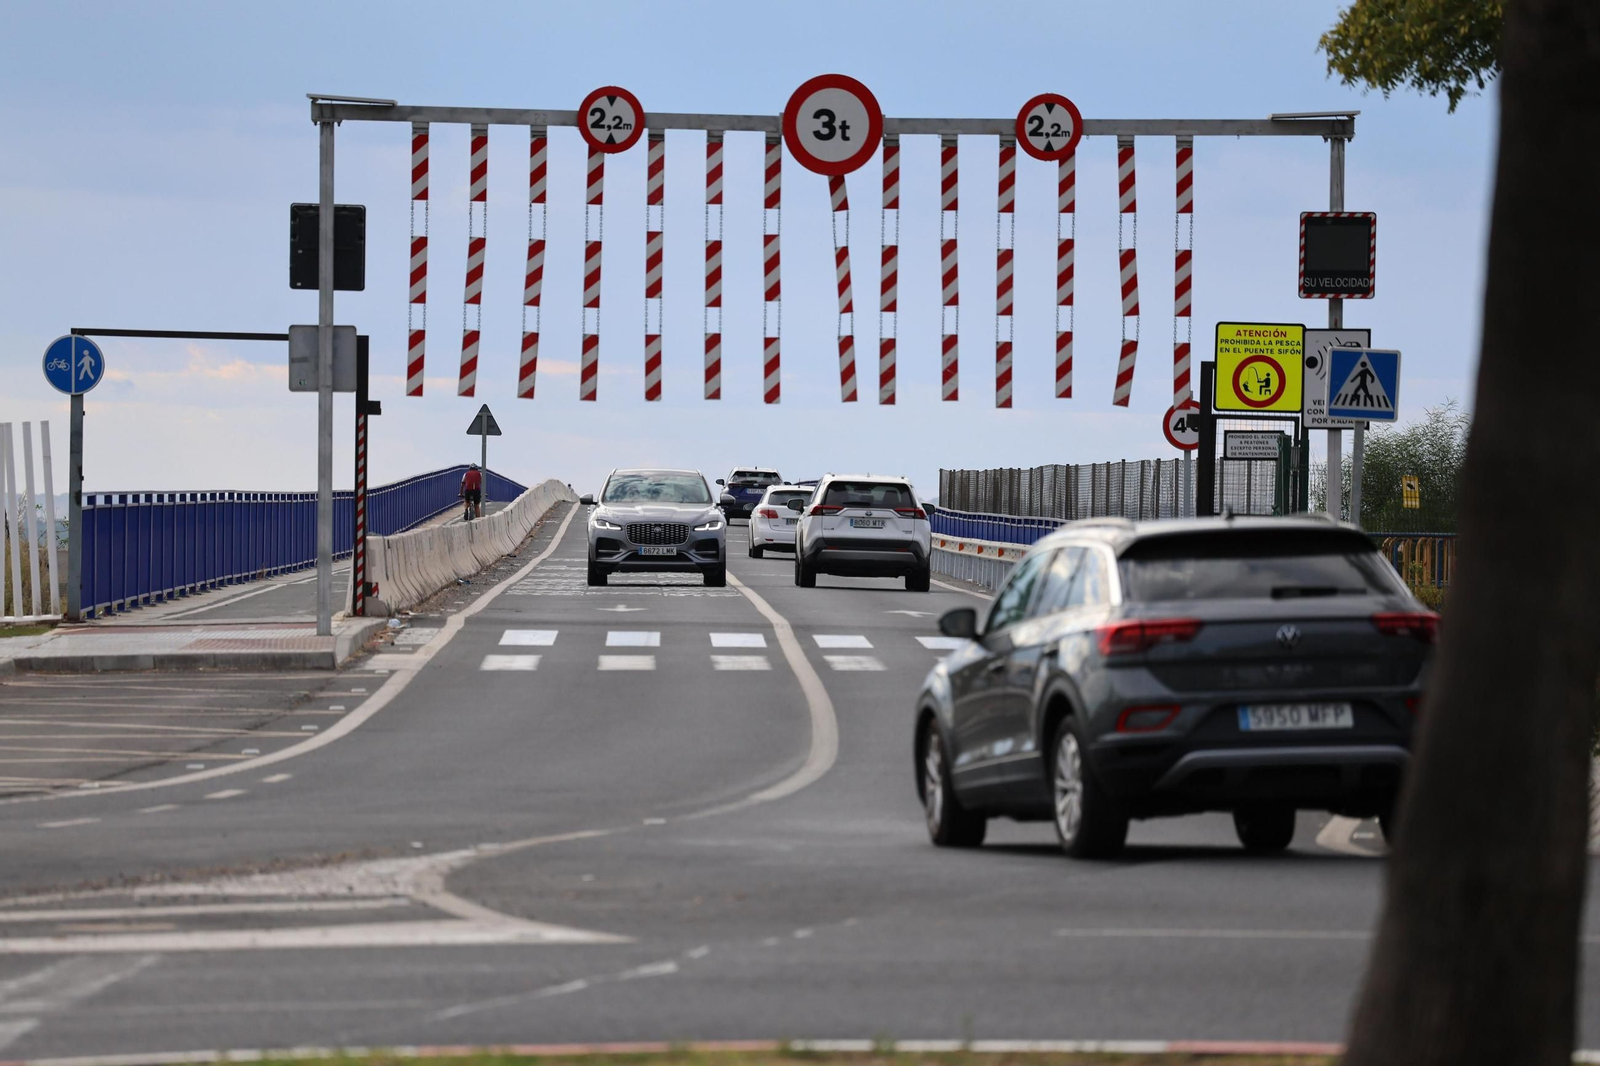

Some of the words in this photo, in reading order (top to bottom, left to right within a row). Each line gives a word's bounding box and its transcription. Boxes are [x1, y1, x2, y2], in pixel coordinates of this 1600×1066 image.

[590, 107, 632, 131] 2,2m
[812, 108, 850, 141] 3t
[1028, 115, 1070, 139] 2,2m
[1304, 277, 1317, 287] SU
[1318, 277, 1370, 288] VELOCIDAD
[1236, 328, 1287, 338] ATENCIÓN
[1220, 338, 1261, 346] PROHIBIDA
[1277, 347, 1301, 355] SIFÓN
